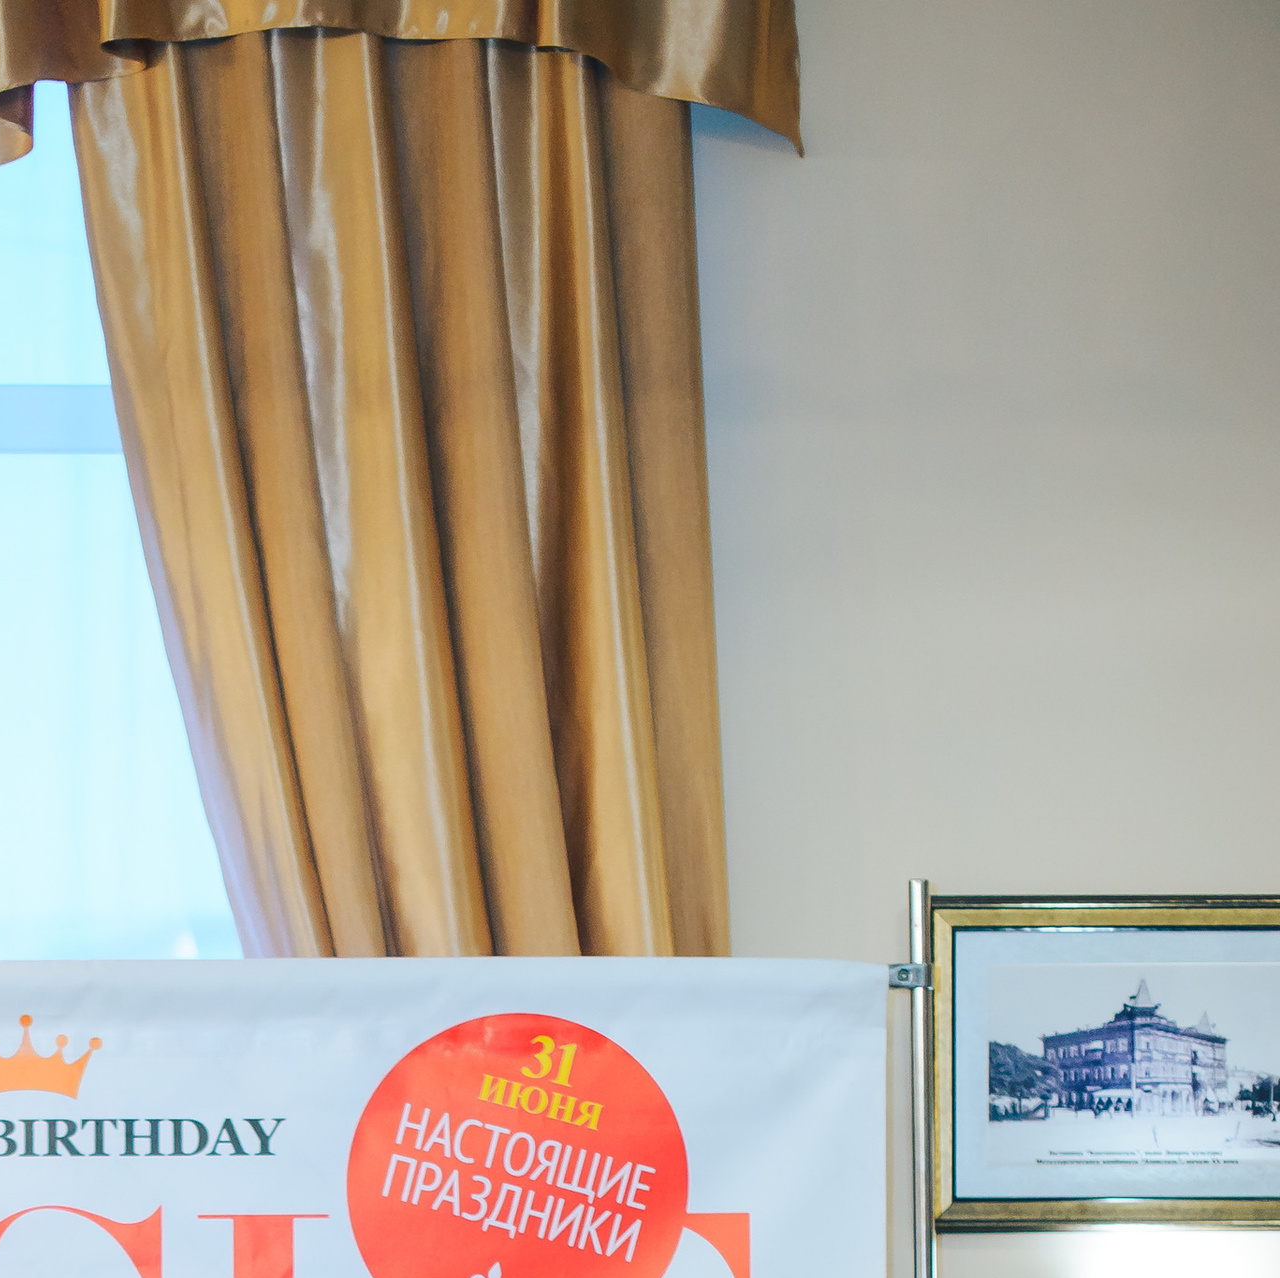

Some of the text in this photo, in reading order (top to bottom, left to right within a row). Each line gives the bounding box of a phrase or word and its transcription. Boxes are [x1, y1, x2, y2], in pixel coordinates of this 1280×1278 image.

[520, 1034, 578, 1088] 31
[381, 1153, 643, 1263] ПРАЗДНИКИ
[395, 1102, 657, 1211] НАСТОЯЩИЕ
